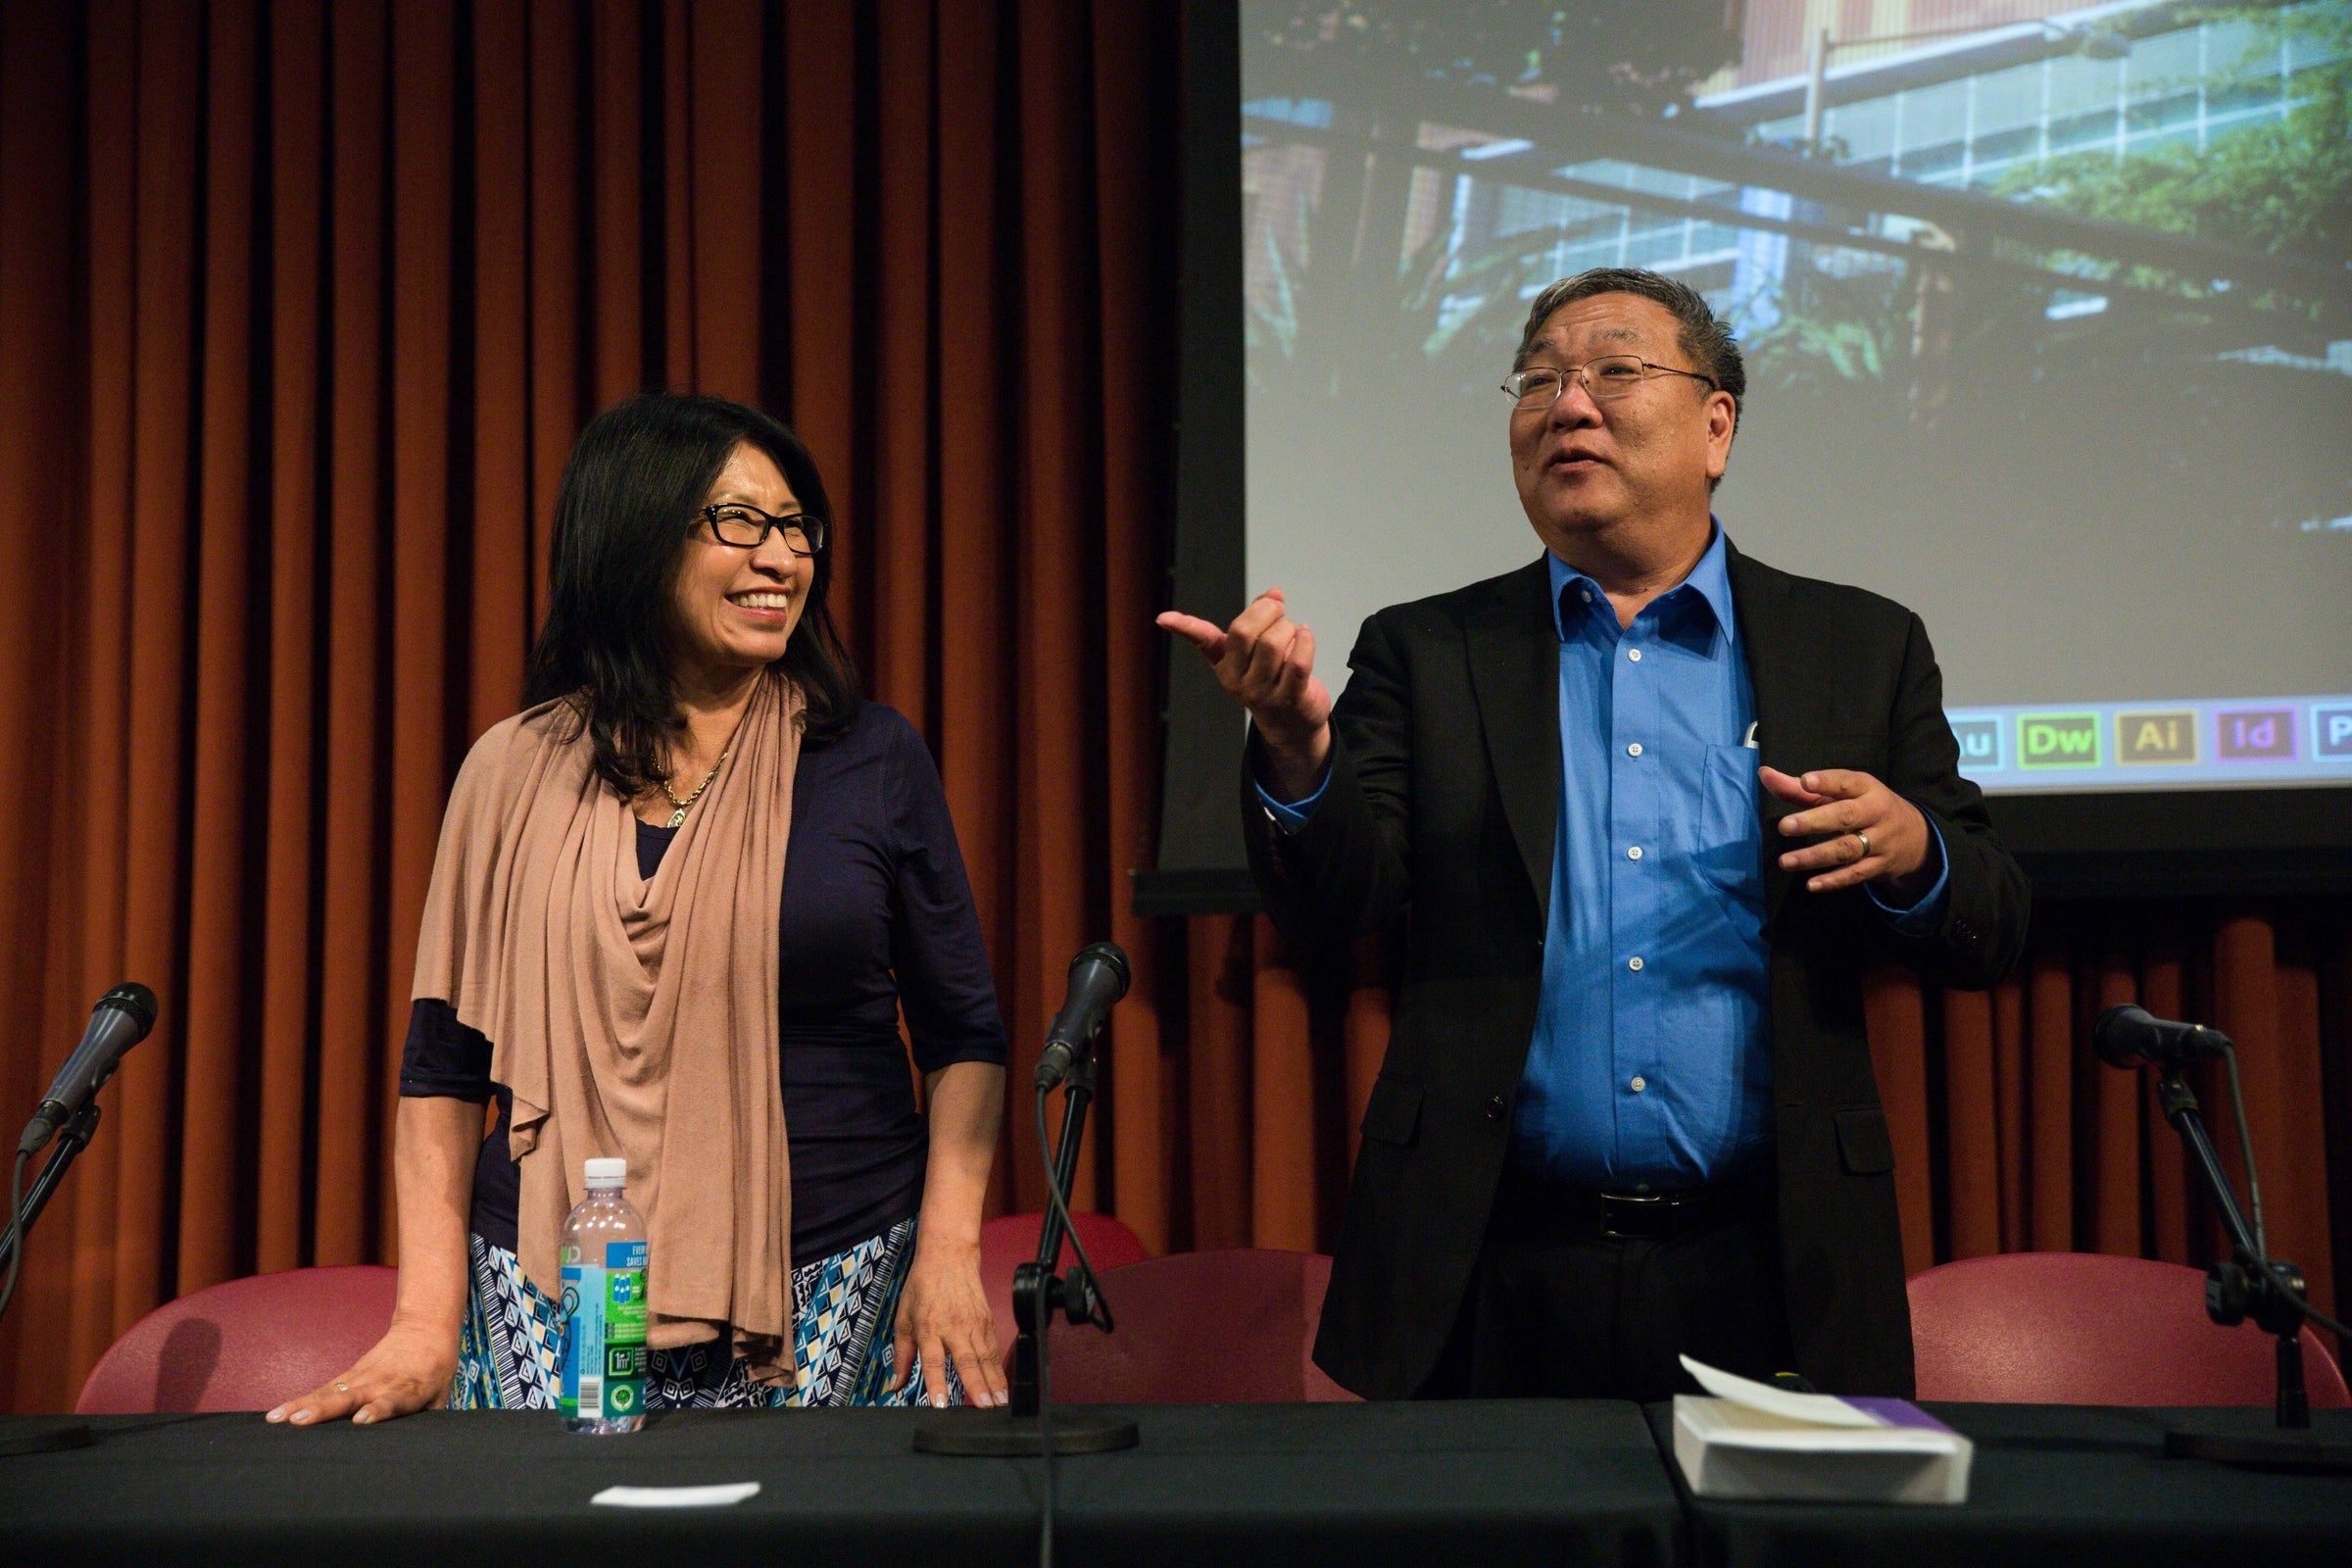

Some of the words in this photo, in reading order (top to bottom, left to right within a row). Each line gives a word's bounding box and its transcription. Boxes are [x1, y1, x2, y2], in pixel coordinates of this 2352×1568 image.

[2028, 725, 2092, 756] Dw
[2134, 720, 2178, 752] Ai
[2232, 717, 2275, 749] Id
